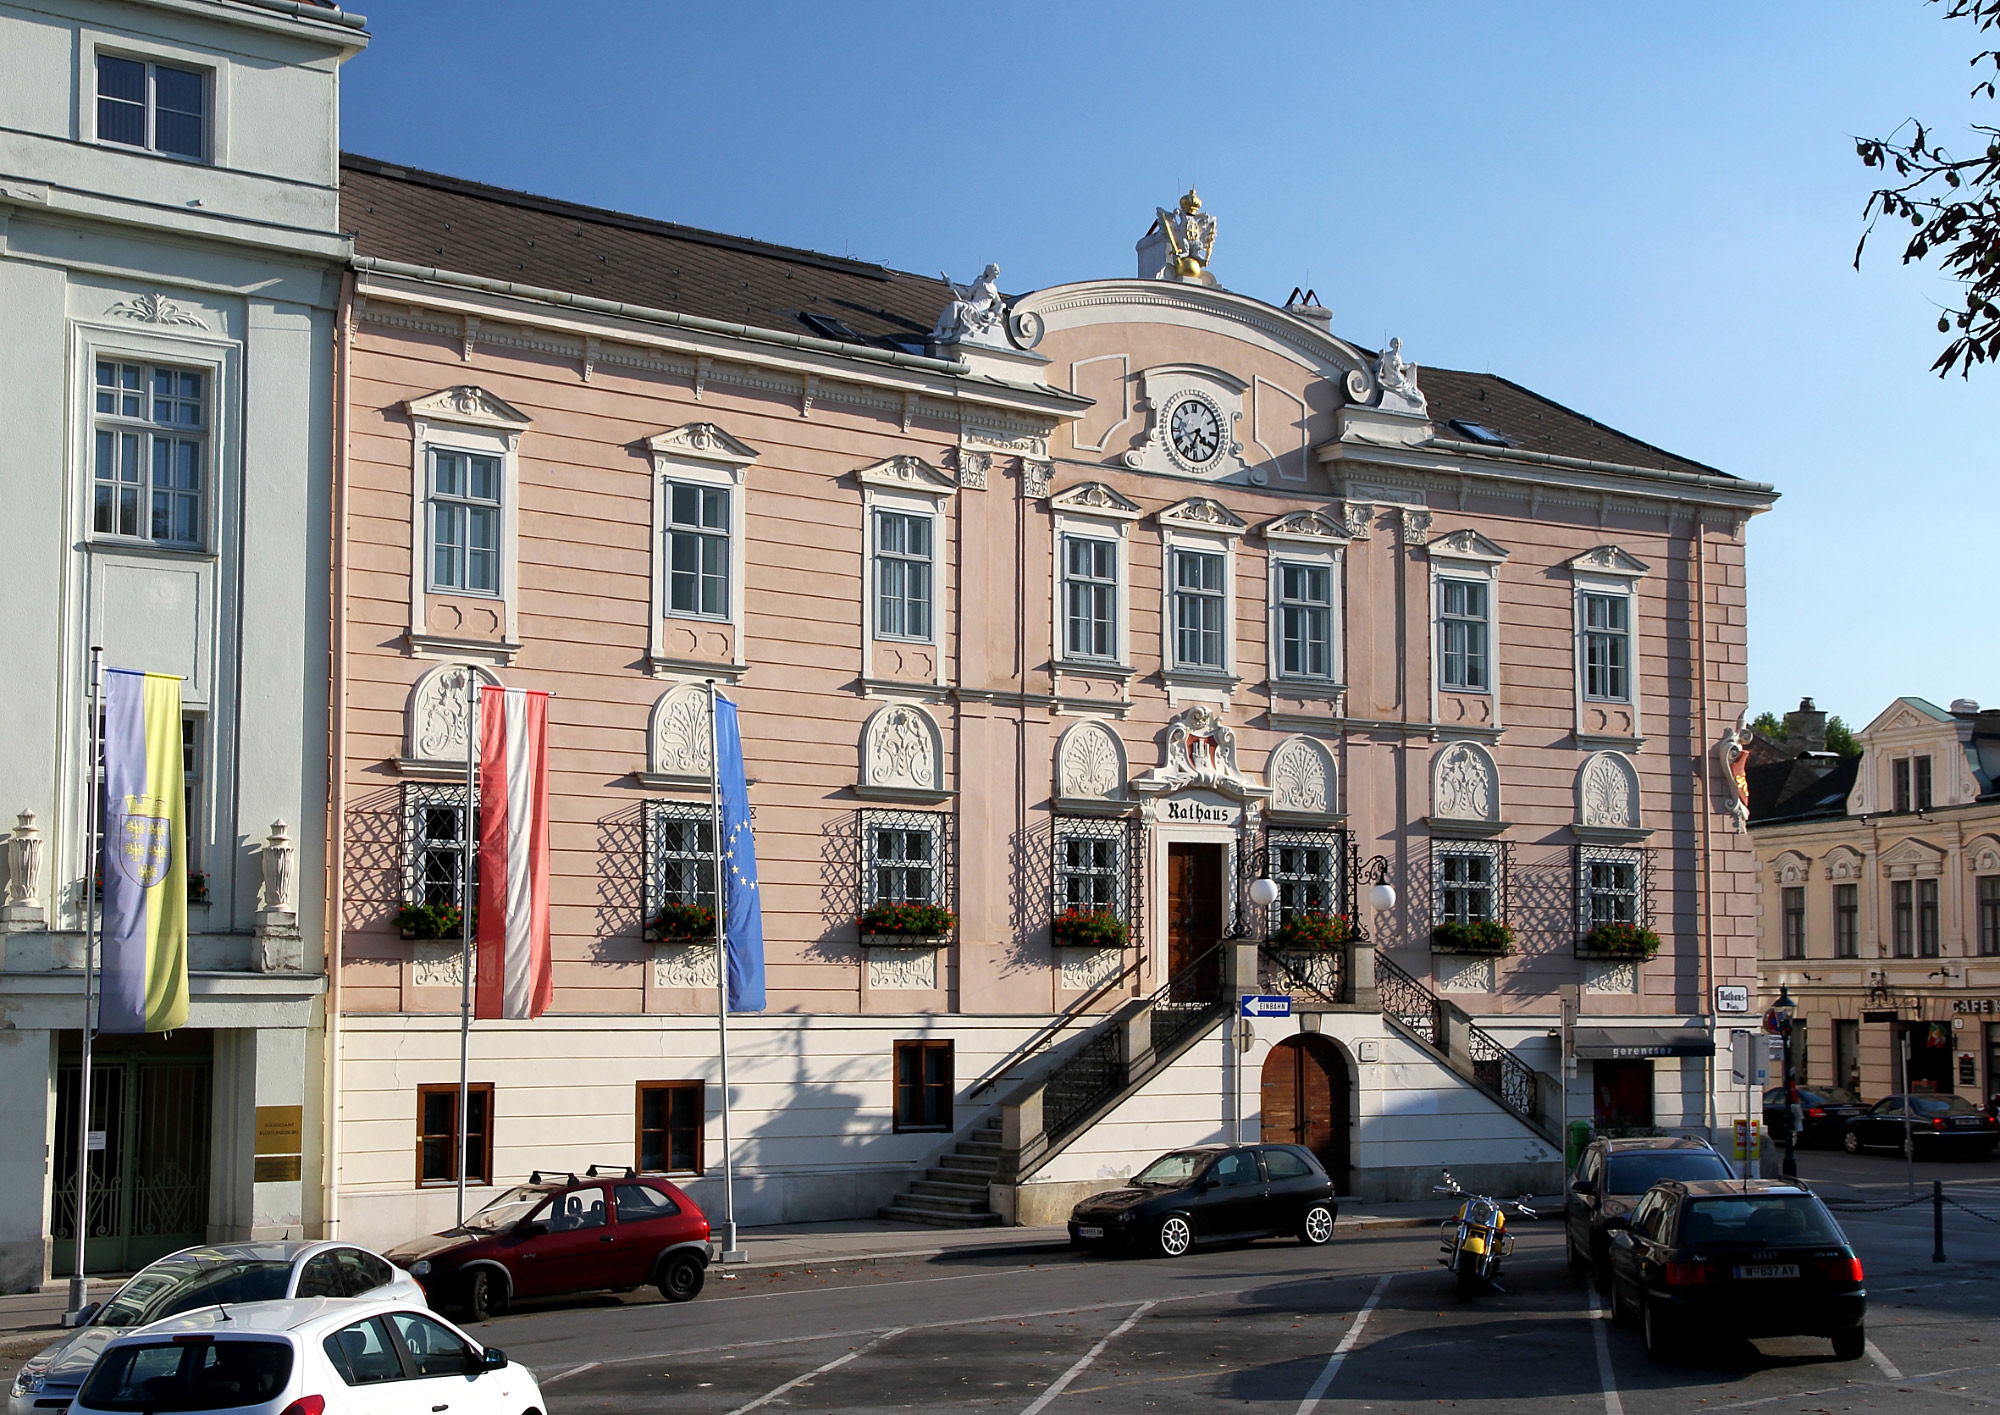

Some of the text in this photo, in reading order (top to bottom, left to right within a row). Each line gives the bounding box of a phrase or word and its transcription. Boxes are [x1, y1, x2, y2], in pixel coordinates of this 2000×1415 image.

[1168, 801, 1229, 823] Rathaus
[1260, 1002, 1286, 1010] EINBAHN
[1612, 1047, 1673, 1058] gerencser
